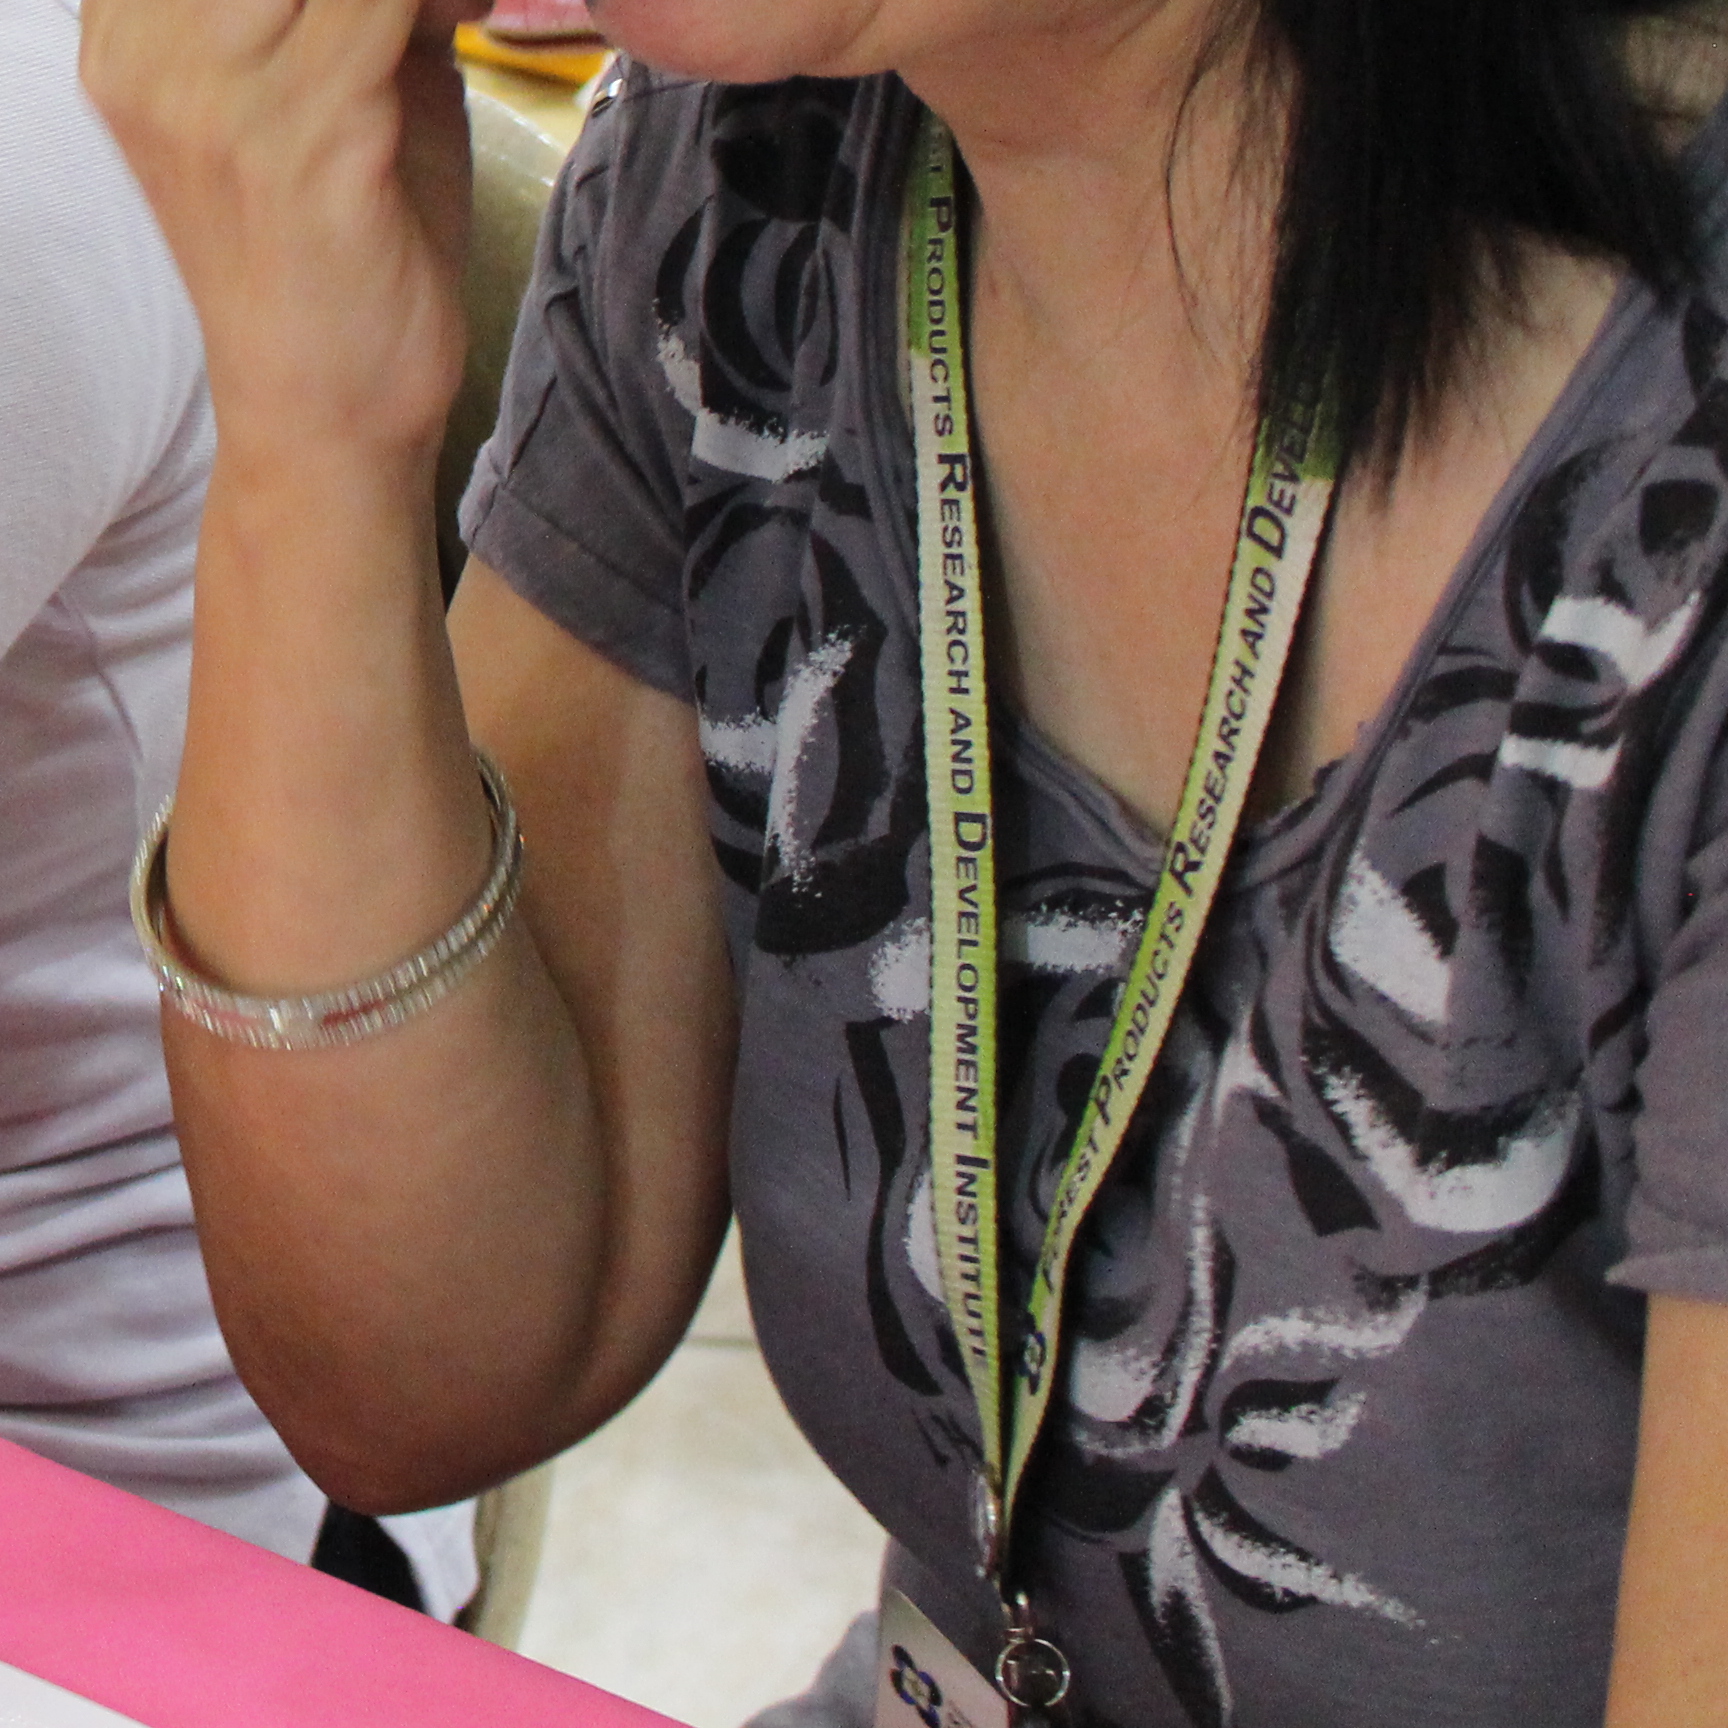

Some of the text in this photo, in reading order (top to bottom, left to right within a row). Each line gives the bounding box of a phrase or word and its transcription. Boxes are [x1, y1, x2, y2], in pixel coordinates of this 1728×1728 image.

[926, 196, 956, 437] PRODUCTS
[936, 453, 971, 694] RESEARCH
[949, 707, 975, 795] AND
[1092, 900, 1185, 1125] PRODUCTS
[1170, 659, 1256, 897] RESEARCH
[1237, 566, 1279, 660] AND
[951, 812, 990, 1140] DEVELOPMENT
